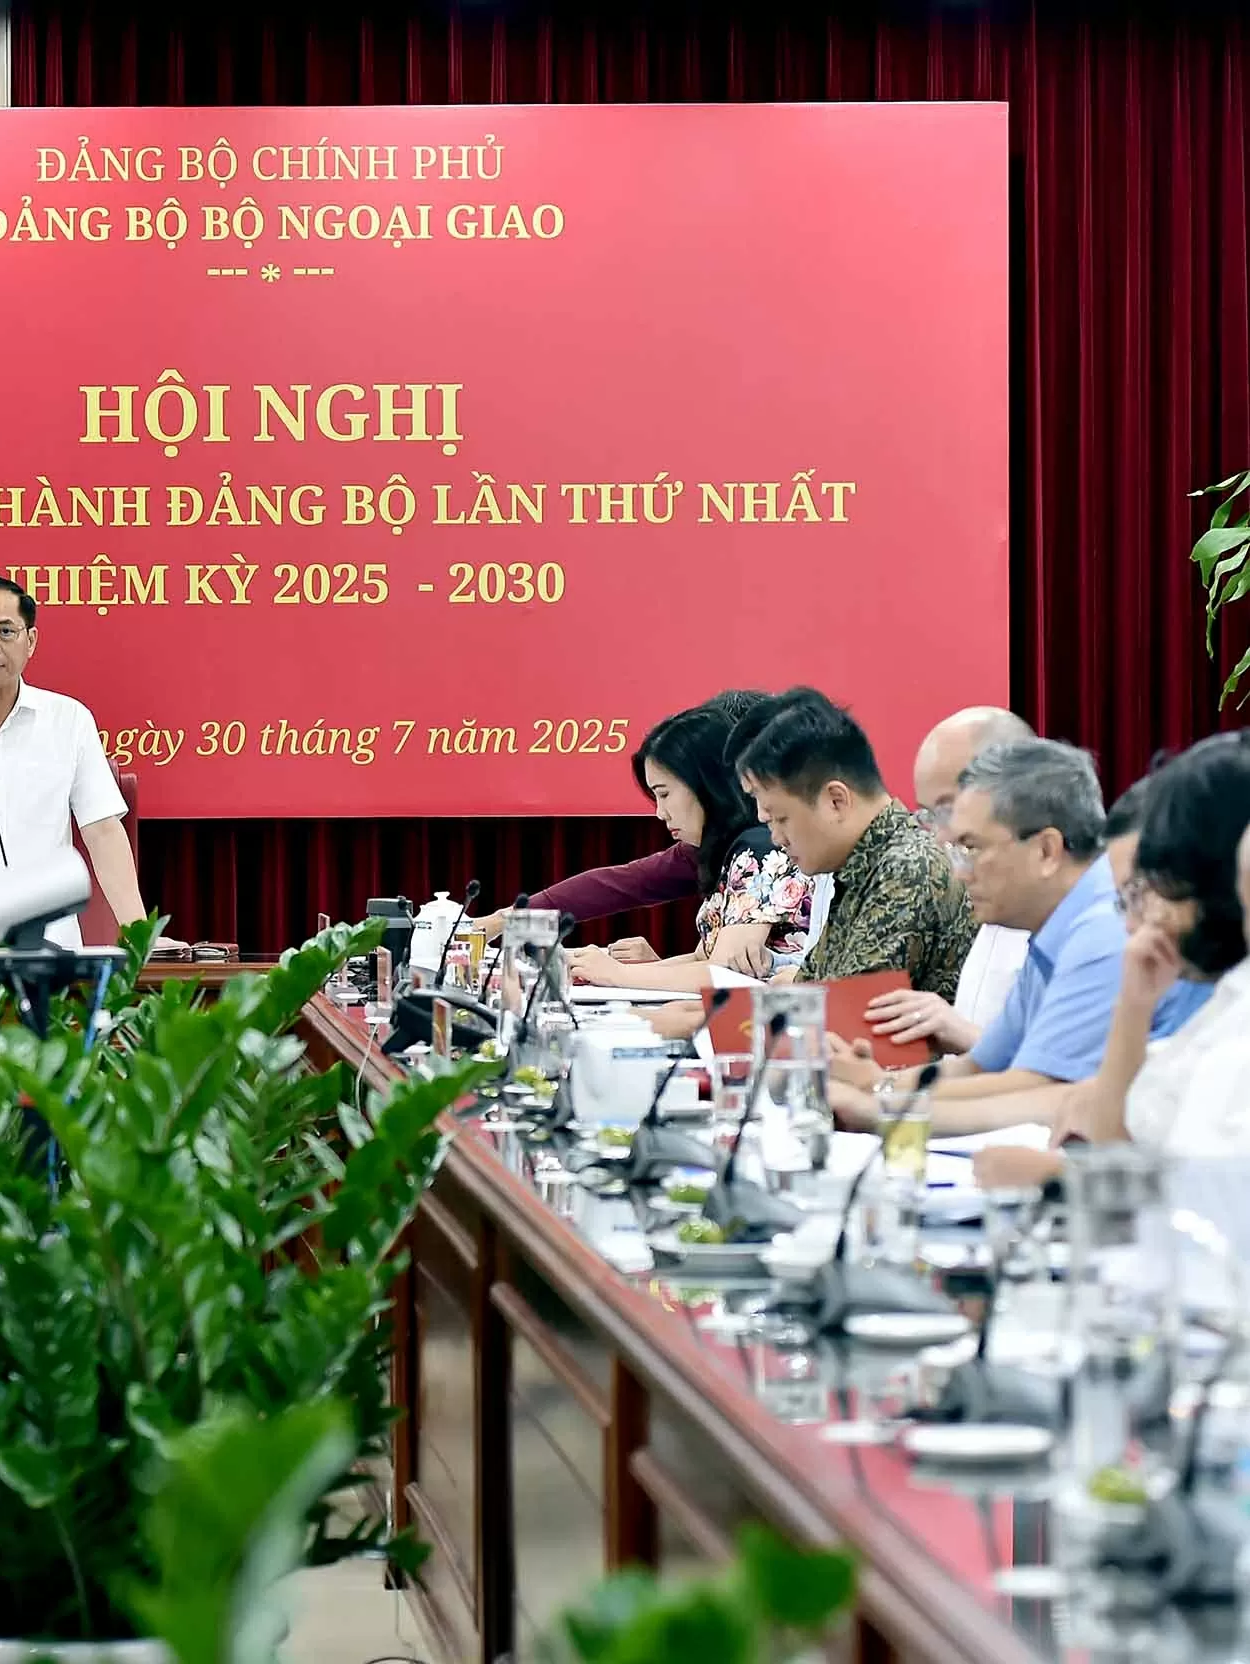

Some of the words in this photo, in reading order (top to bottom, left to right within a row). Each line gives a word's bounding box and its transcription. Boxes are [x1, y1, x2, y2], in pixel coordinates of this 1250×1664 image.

[36, 135, 164, 183] ĐẢNG
[178, 136, 238, 188] BỘ
[252, 135, 397, 181] CHÍNH
[413, 133, 505, 181] PHỦ
[125, 197, 188, 250] BỘ
[201, 196, 264, 249] BỘ
[278, 204, 433, 249] NGOẠI
[446, 204, 565, 240] GIAO
[78, 368, 231, 458] HỘI
[253, 383, 463, 456] NGHỊ
[165, 471, 327, 526] ĐẢNG
[341, 473, 416, 536] BỘ
[432, 471, 547, 525] LẦN
[560, 471, 684, 524] THỨ
[699, 468, 857, 523] NHẤT
[185, 553, 260, 604] KỲ
[273, 563, 389, 605] 2025
[448, 562, 565, 604] 2030
[196, 720, 246, 756] 30
[260, 719, 381, 765] tháng
[393, 720, 416, 753] 7
[427, 719, 518, 754] năm
[528, 718, 630, 754] 2025
